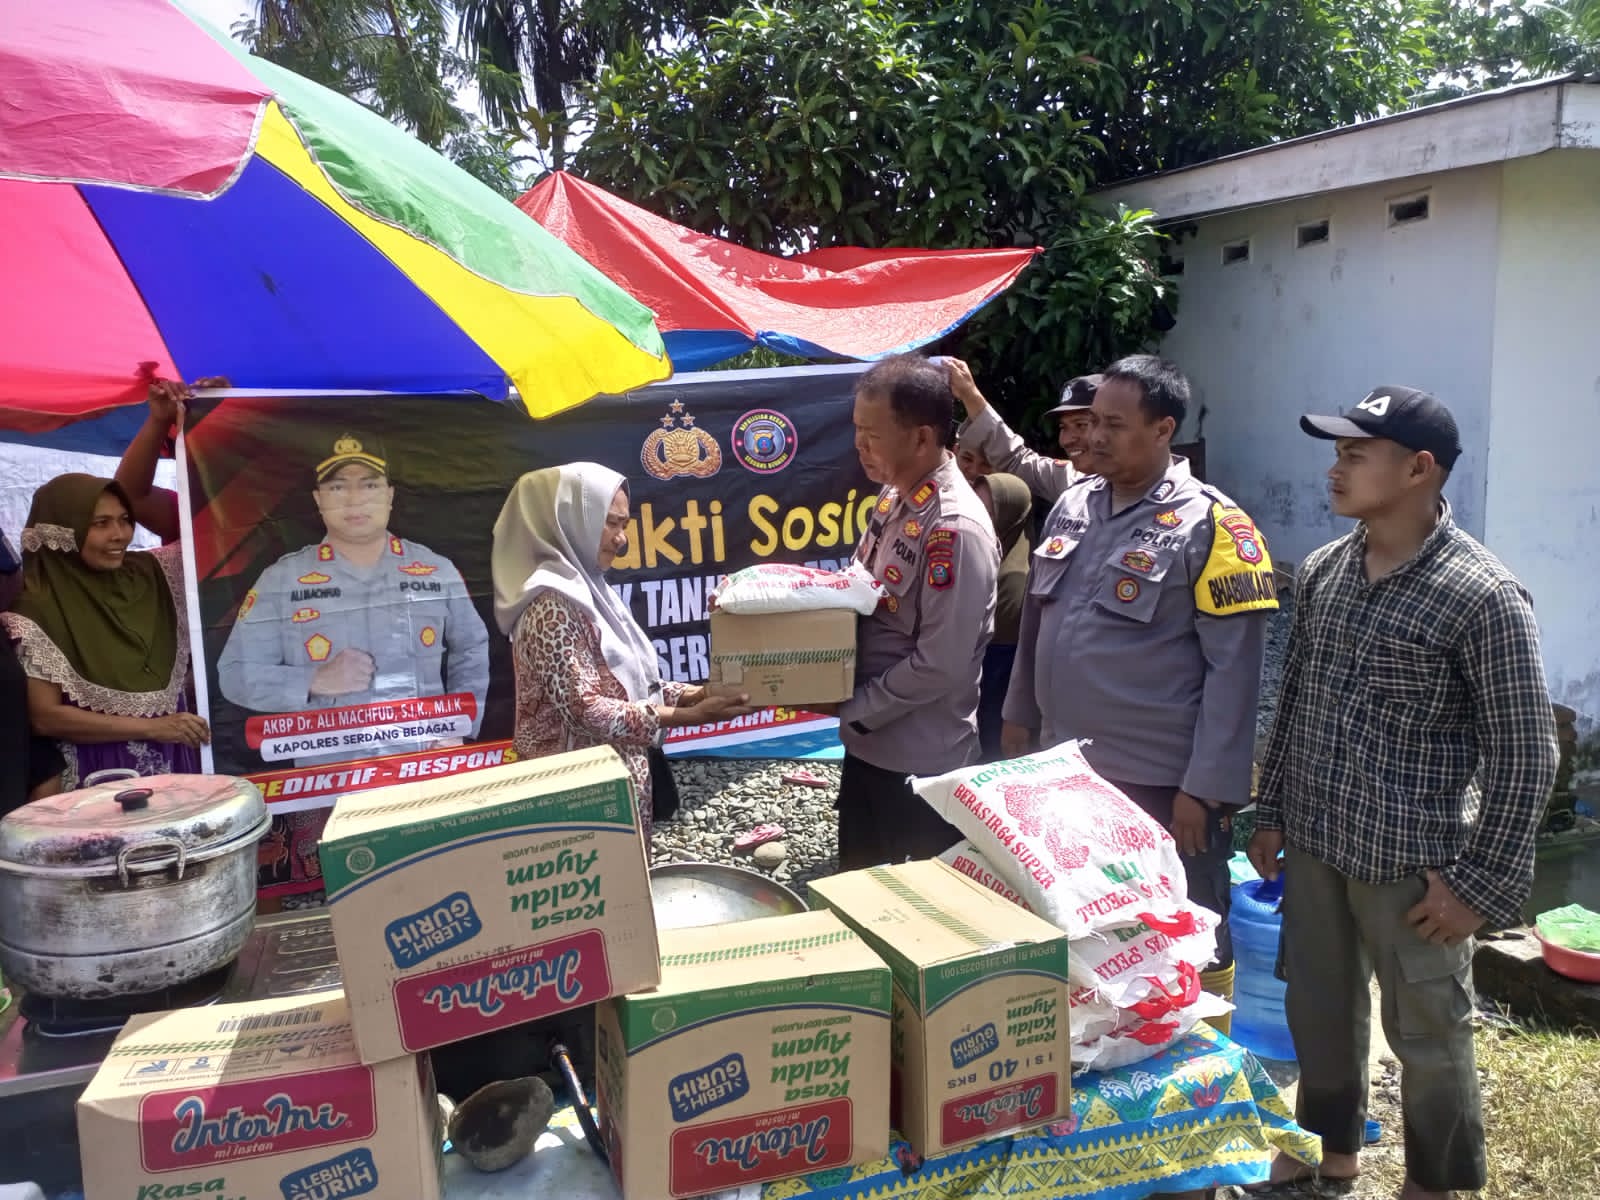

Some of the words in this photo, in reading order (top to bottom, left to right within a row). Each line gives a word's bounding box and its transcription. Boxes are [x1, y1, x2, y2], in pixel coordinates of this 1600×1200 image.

[610, 500, 726, 570] akti
[400, 581, 441, 593] POLRI
[651, 634, 712, 682] SER
[263, 718, 293, 736] AKBP
[297, 715, 313, 731] Dr.
[317, 712, 335, 728] ALI
[273, 736, 339, 755] KAPOLRES
[343, 729, 399, 746] SERDANG
[404, 721, 457, 738] BEDAGAI
[399, 747, 519, 778] RESPONS
[953, 783, 991, 821] BERAS
[984, 813, 1016, 847] IR64
[1010, 841, 1056, 890] SUPER
[505, 848, 599, 886] Ayam
[951, 854, 993, 889] BERAS
[511, 875, 601, 912] Kaldu
[390, 899, 470, 949] GURIH
[531, 901, 606, 930] Rasa
[414, 921, 463, 956] LEBIH
[423, 949, 583, 1017] InterMi
[1007, 998, 1057, 1020] Ayam
[1007, 1014, 1057, 1036] Kaldu
[1016, 1030, 1057, 1047] Rasa
[772, 1028, 852, 1058] Ayam
[952, 1026, 994, 1057] GURIH
[673, 1060, 742, 1102] GURIH
[770, 1055, 850, 1085] Kaldu
[947, 1072, 977, 1089] BKS
[989, 1058, 1019, 1081] 40
[690, 1080, 734, 1111] LEBIH
[784, 1079, 851, 1101] Rasa
[955, 1084, 1043, 1126] InterMi
[172, 1093, 349, 1153] InterMi
[232, 1141, 273, 1157] instan
[694, 1115, 831, 1169] InterMi
[136, 1177, 225, 1200] Rasa
[300, 1159, 352, 1190] LEBIH
